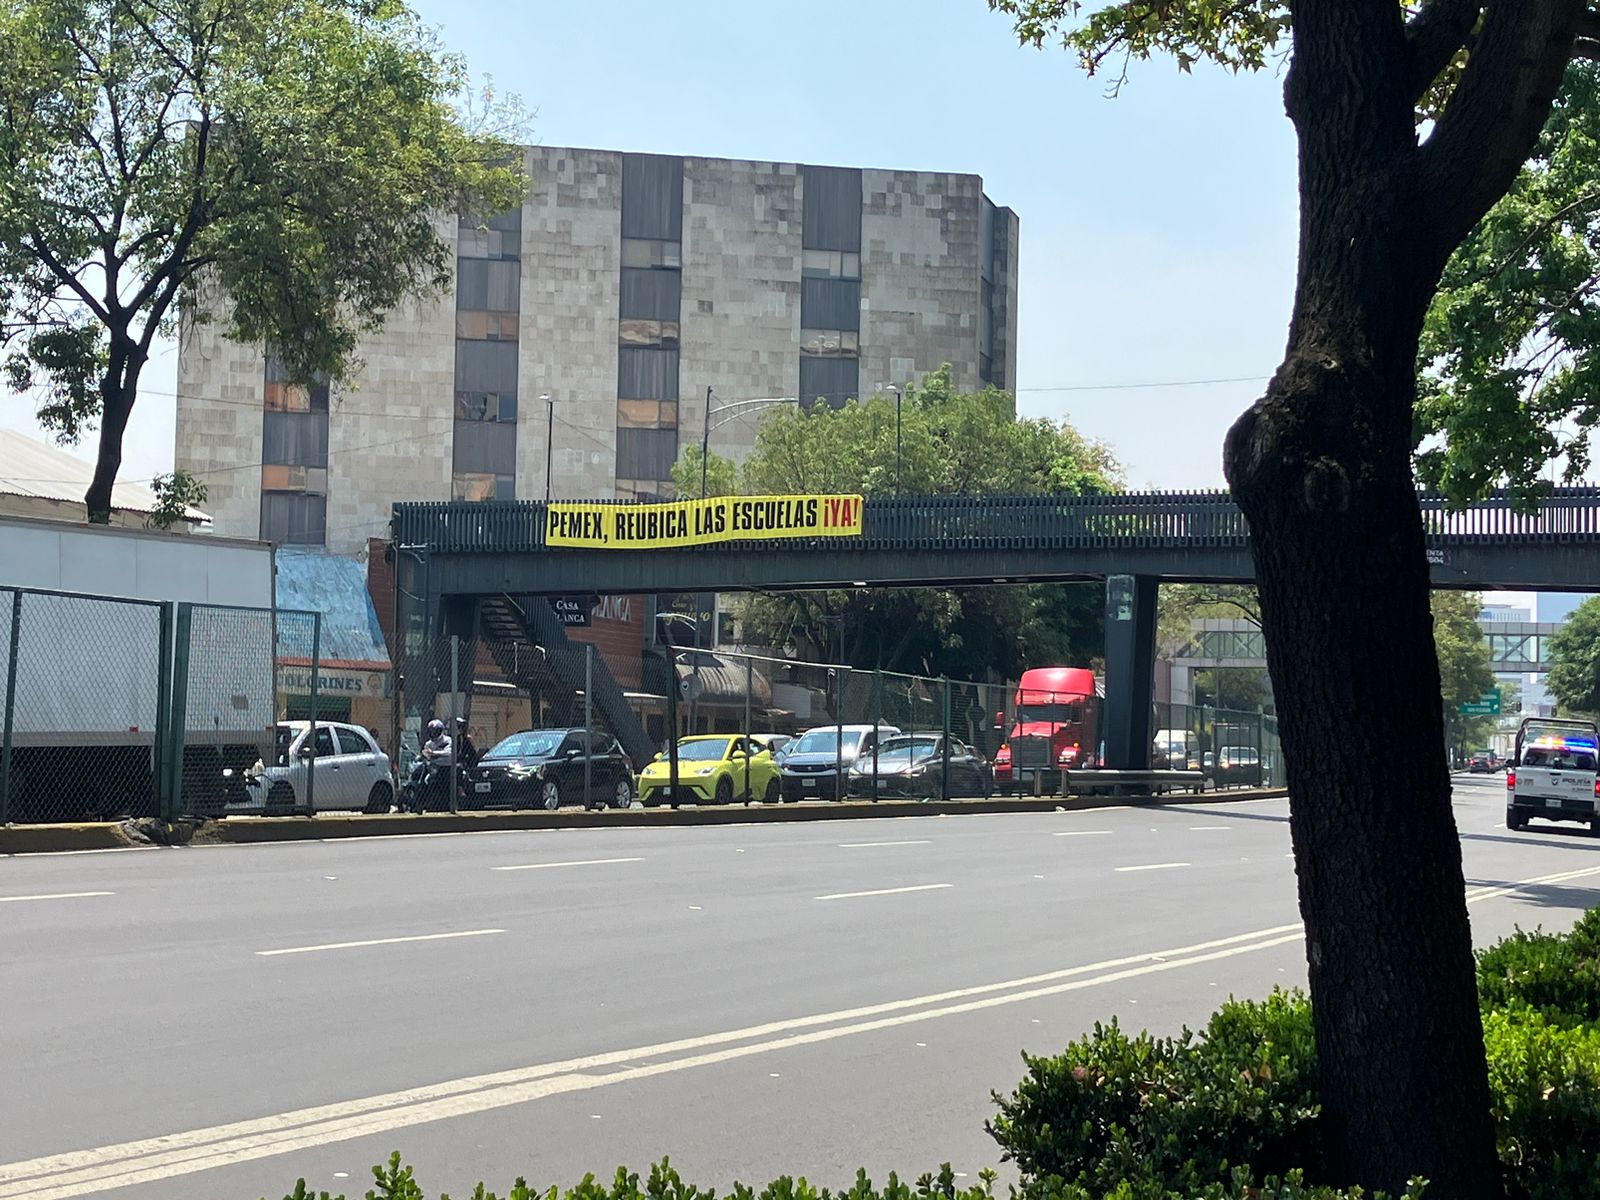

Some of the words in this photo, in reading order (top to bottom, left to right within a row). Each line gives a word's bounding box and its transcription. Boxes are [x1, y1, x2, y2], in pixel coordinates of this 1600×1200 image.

[549, 510, 609, 544] PEMEX,
[615, 510, 688, 541] REUBICA
[695, 505, 726, 536] LAS
[732, 499, 818, 532] ESCUELAS
[823, 497, 859, 528] ¡YA!
[553, 612, 585, 623] LANCA
